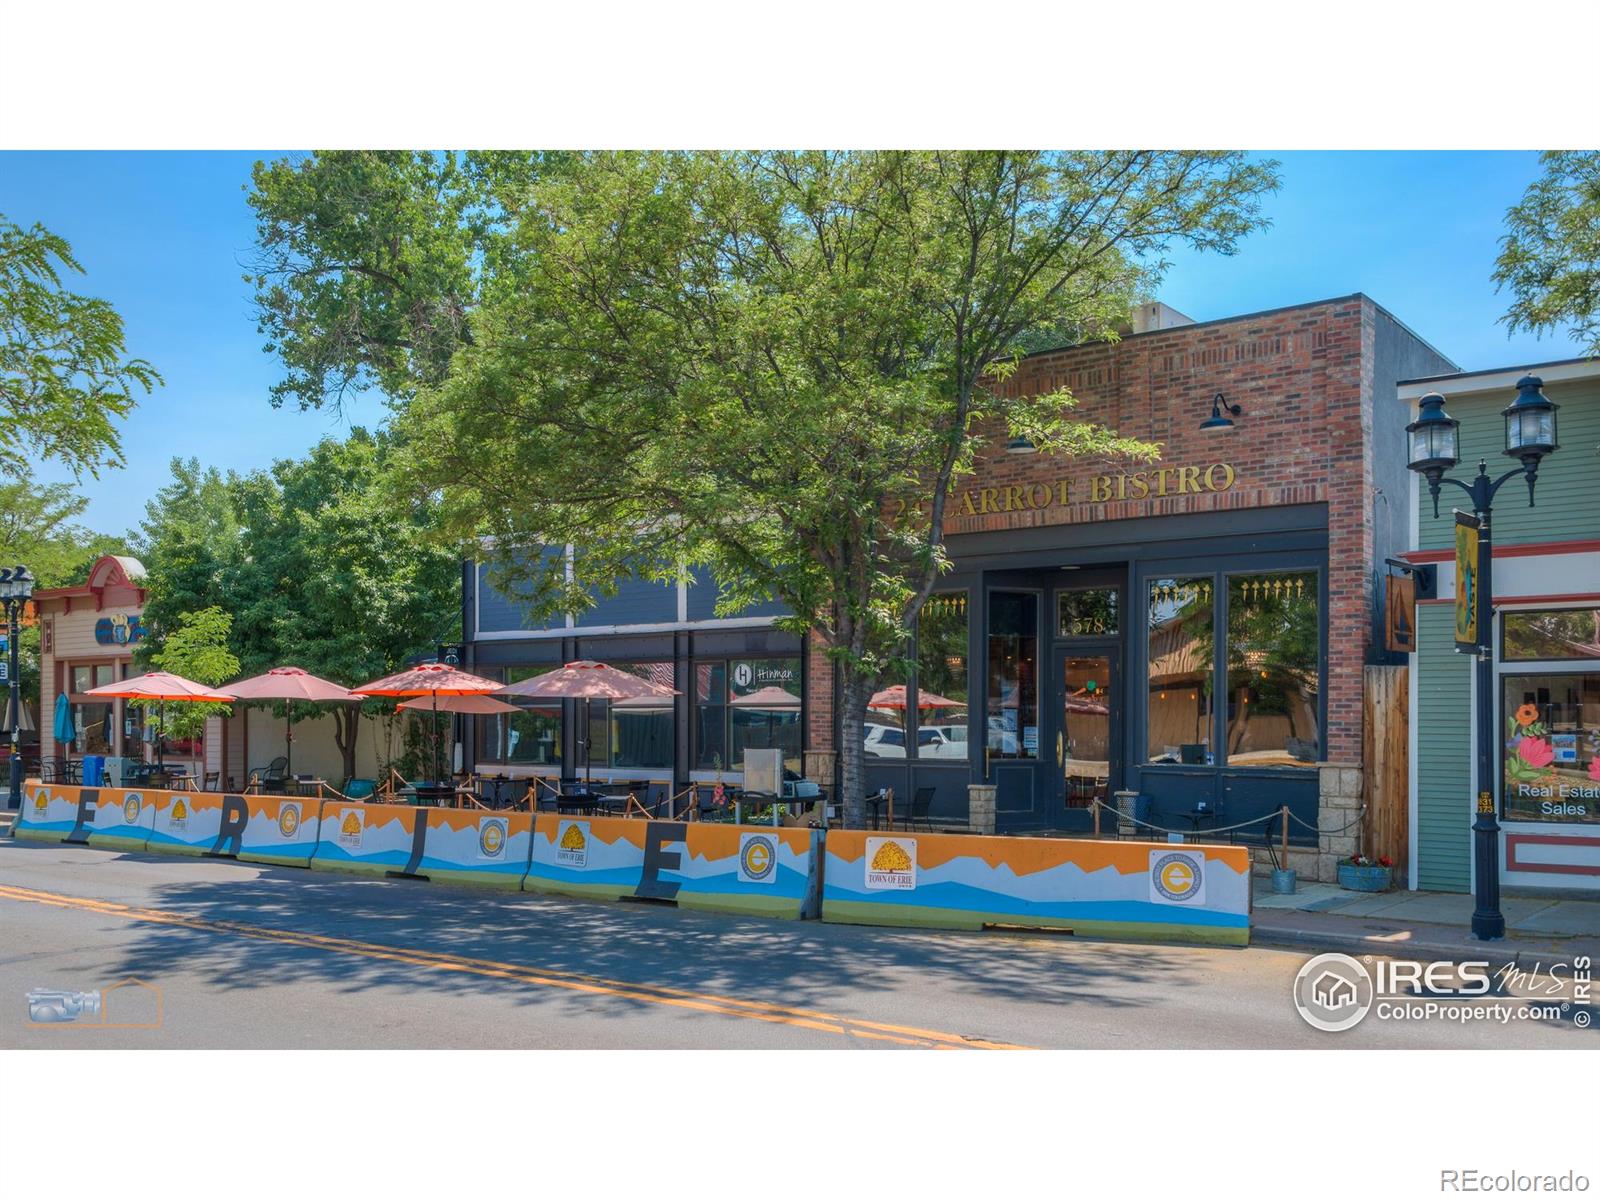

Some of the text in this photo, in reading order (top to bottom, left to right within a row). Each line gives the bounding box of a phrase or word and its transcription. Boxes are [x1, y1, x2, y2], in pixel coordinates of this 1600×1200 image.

[1090, 463, 1236, 502] BISTRO
[1072, 617, 1104, 634] 578
[757, 667, 793, 680] Hinman
[1518, 783, 1554, 798] Real
[1541, 801, 1587, 816] Sales
[868, 874, 913, 885] TOWN OF ERIE
